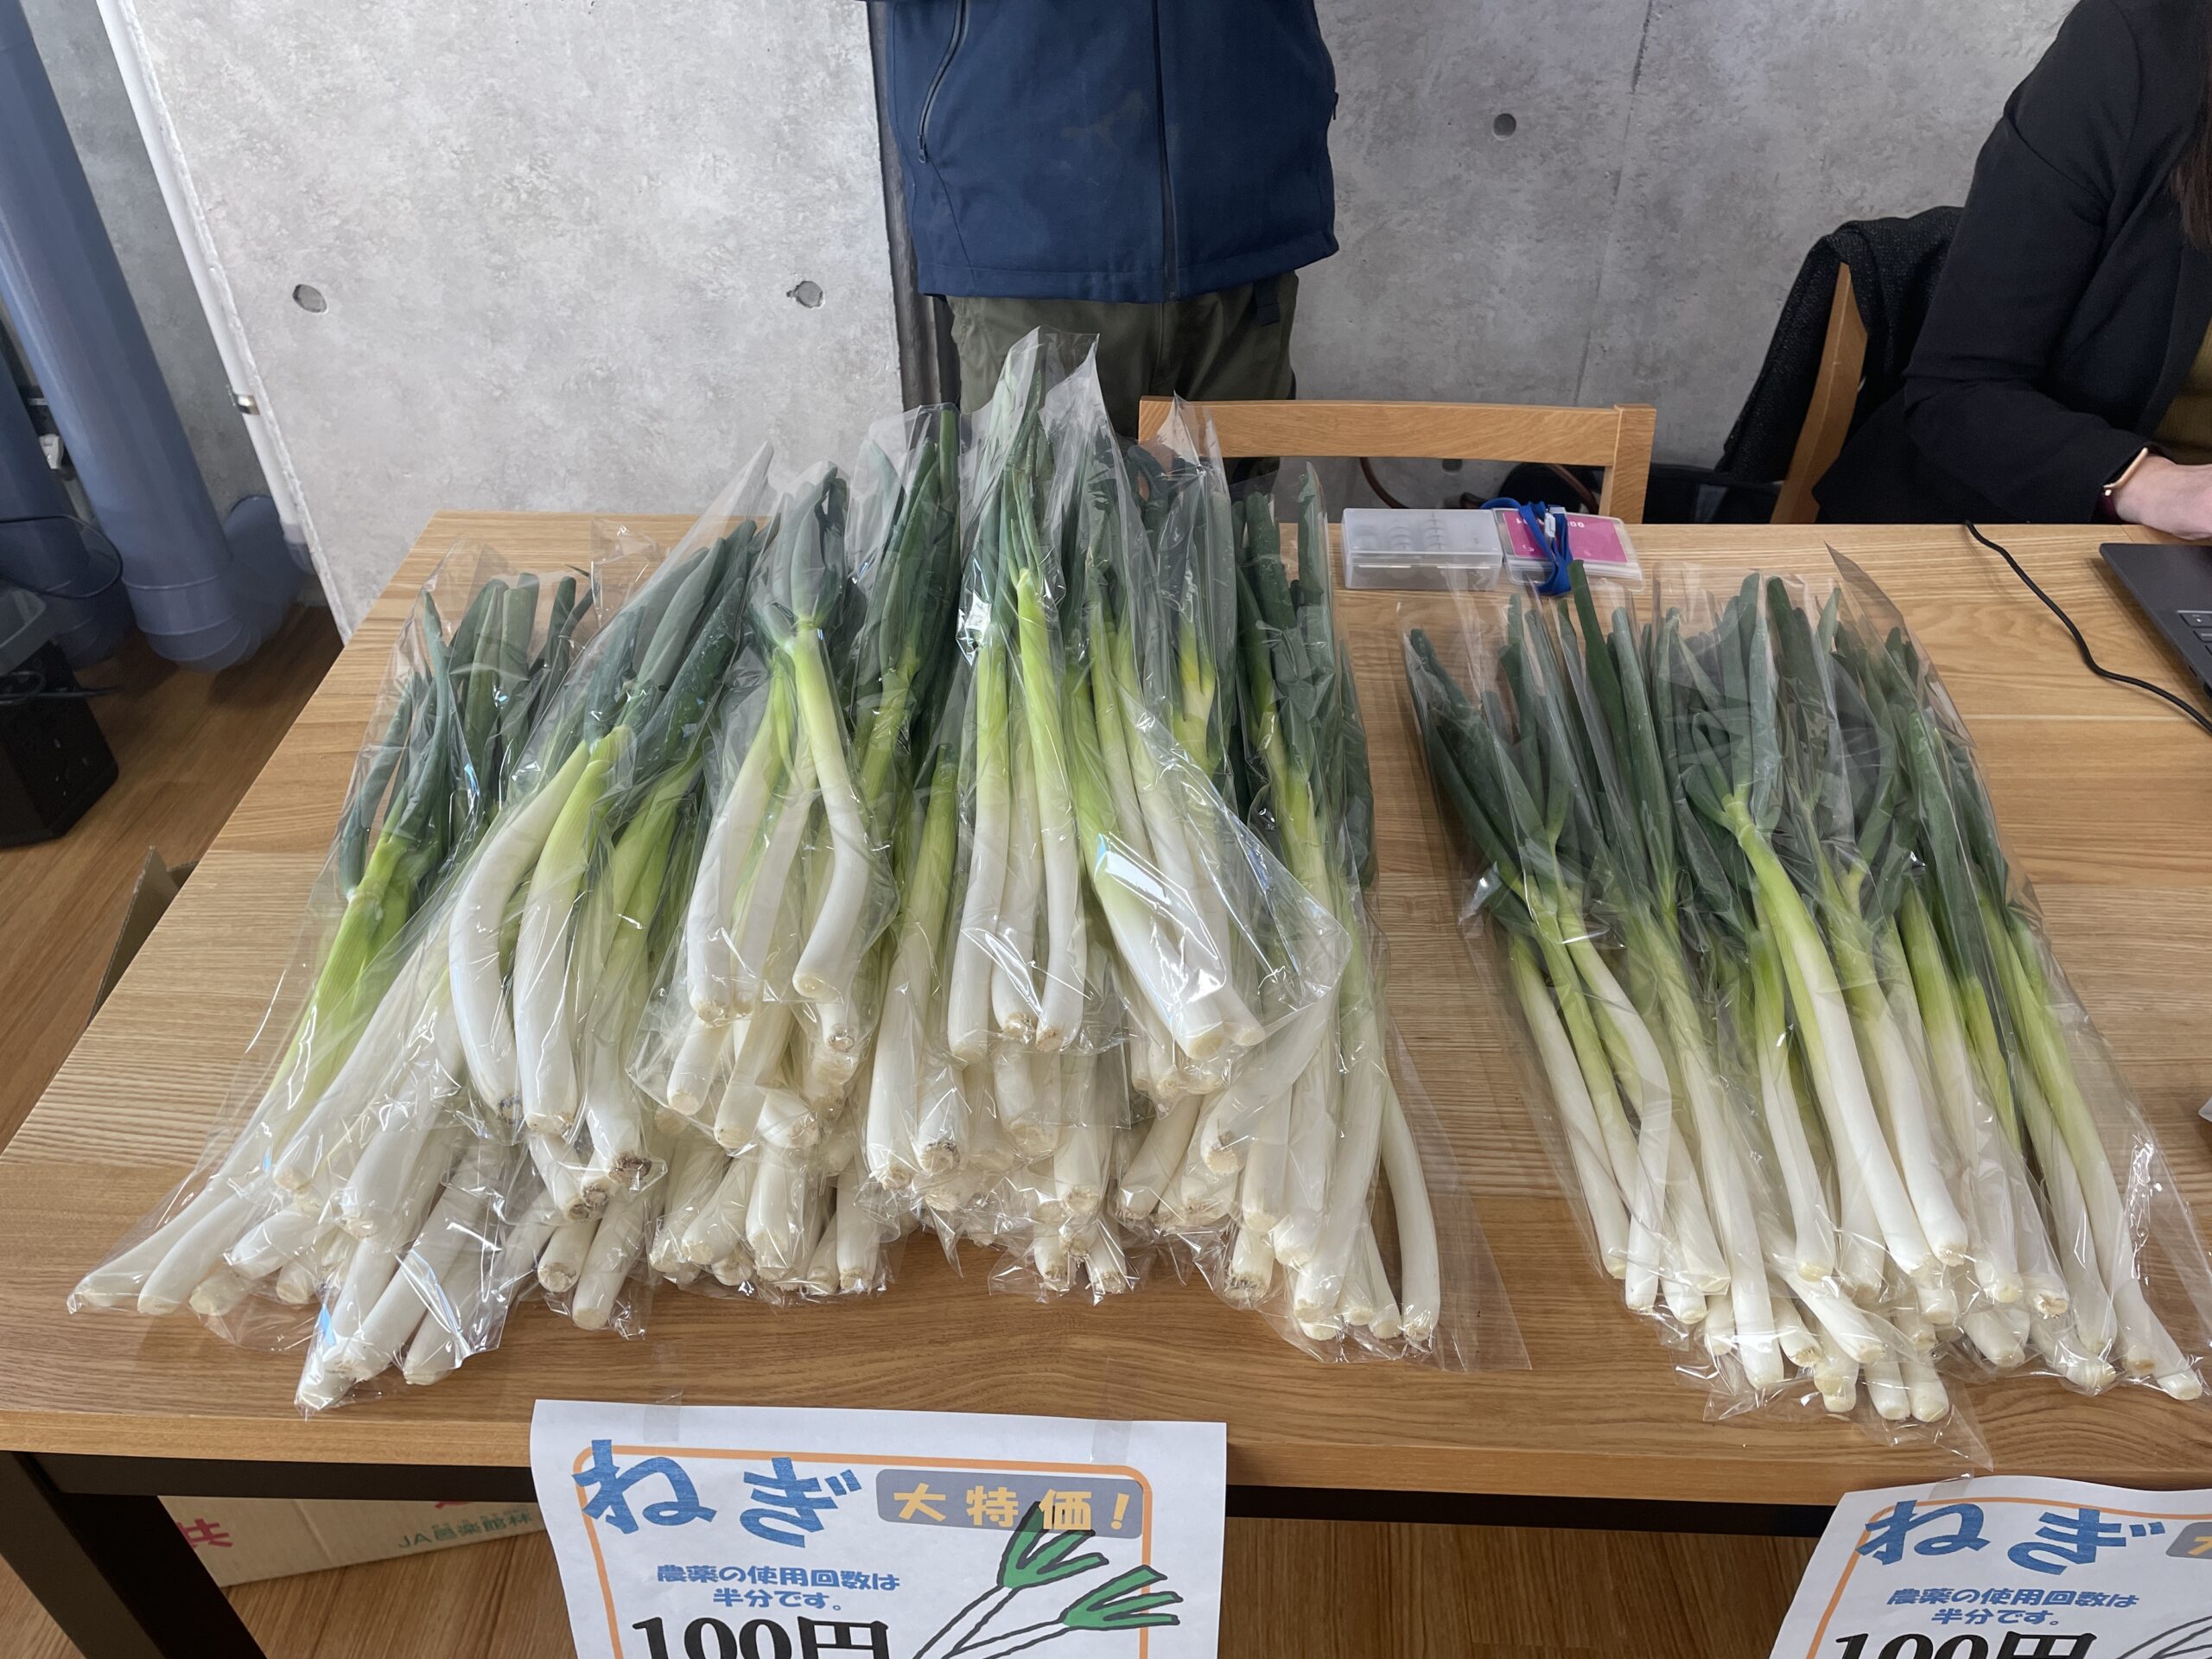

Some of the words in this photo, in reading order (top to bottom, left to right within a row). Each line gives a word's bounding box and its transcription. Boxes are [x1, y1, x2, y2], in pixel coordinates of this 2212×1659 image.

[572, 1440, 862, 1548] ねぎ
[893, 1483, 1129, 1530] 大特価！
[1855, 1499, 2165, 1575] ねぎ
[657, 1564, 899, 1591] 農薬の使用回数は
[713, 1587, 842, 1611] 半分です。
[1886, 1588, 2139, 1608] 農薬の使用回数は
[1931, 1608, 2059, 1625] 半分です。
[632, 1616, 890, 1659] 100円
